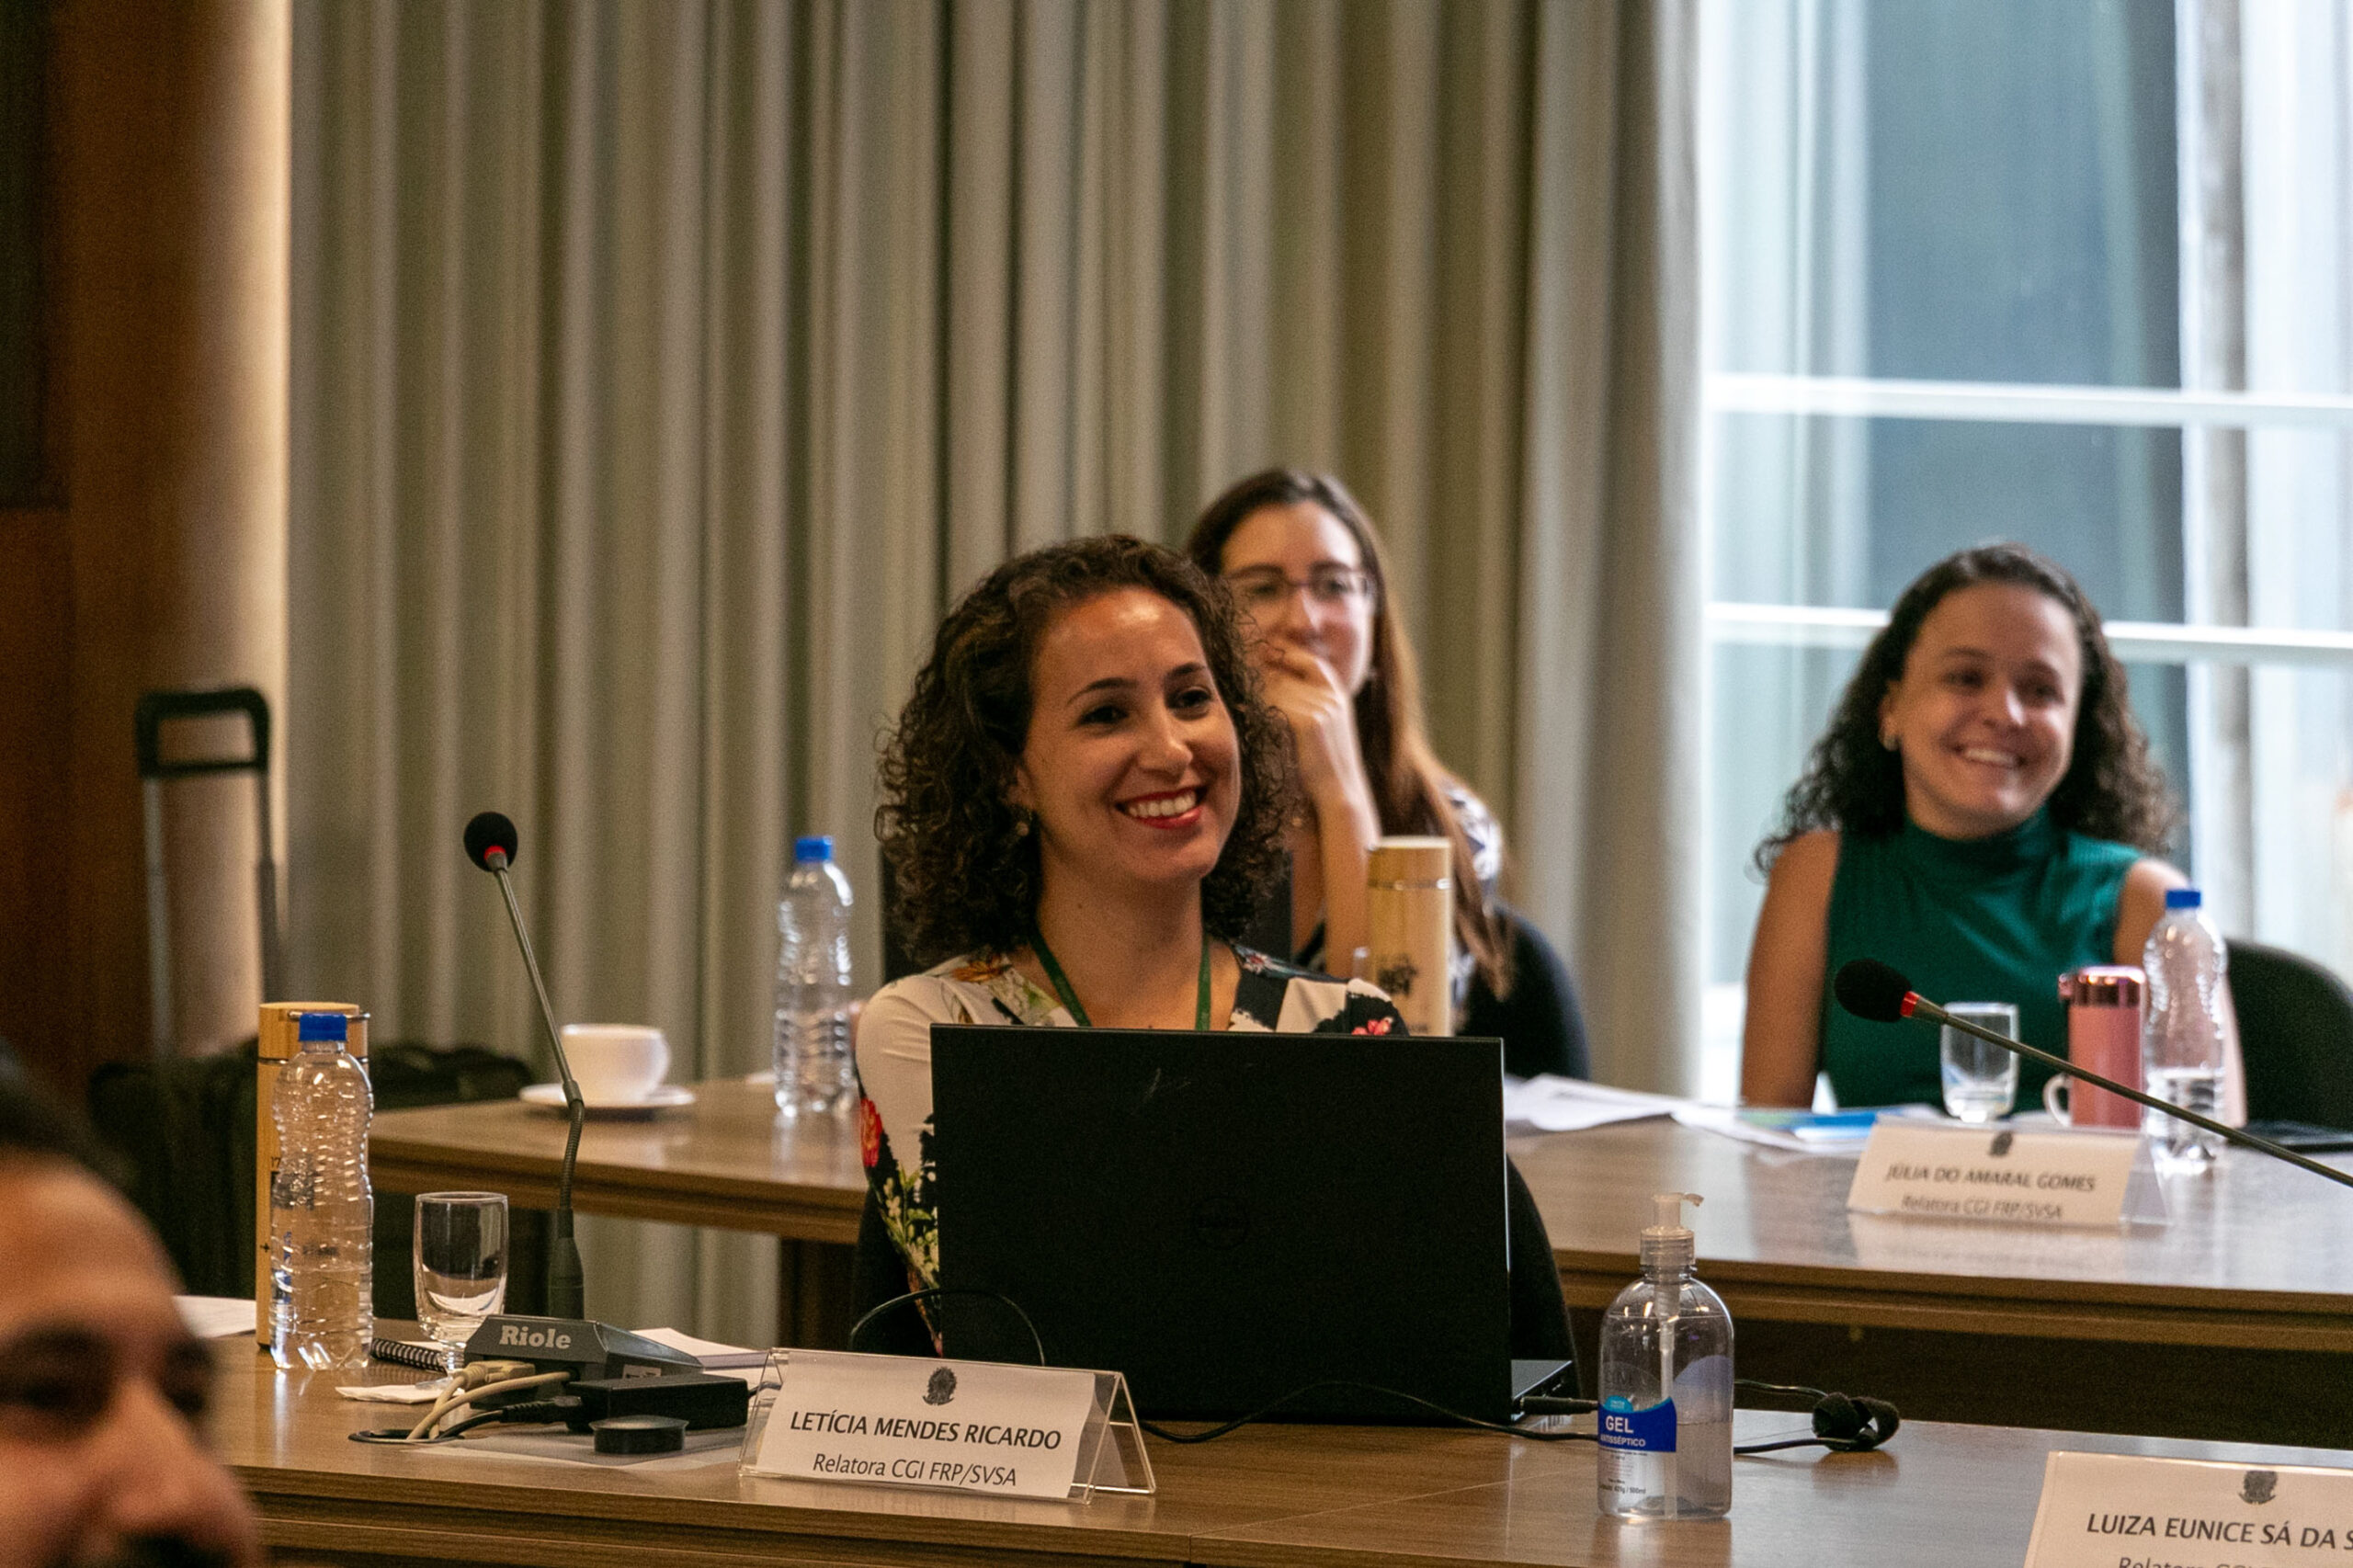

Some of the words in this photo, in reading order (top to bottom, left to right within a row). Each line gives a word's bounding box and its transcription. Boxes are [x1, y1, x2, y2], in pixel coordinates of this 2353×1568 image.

[1934, 1167, 1960, 1183] DO
[1963, 1169, 2031, 1188] AMARAL
[2037, 1174, 2097, 1192] GOMES
[499, 1324, 572, 1349] Riole
[790, 1409, 868, 1435] LETÍCIA
[873, 1416, 960, 1442] MENDES
[964, 1424, 1062, 1449] RICARDO
[1606, 1415, 1634, 1434] GEL
[813, 1453, 885, 1476] Relatora
[892, 1459, 925, 1479] CGI
[929, 1462, 1017, 1485] FRP/SVSA
[2086, 1513, 2156, 1537] LUIZA
[2164, 1517, 2255, 1543] EUNICE
[2260, 1520, 2291, 1546] SÁ
[2300, 1527, 2336, 1550] DA
